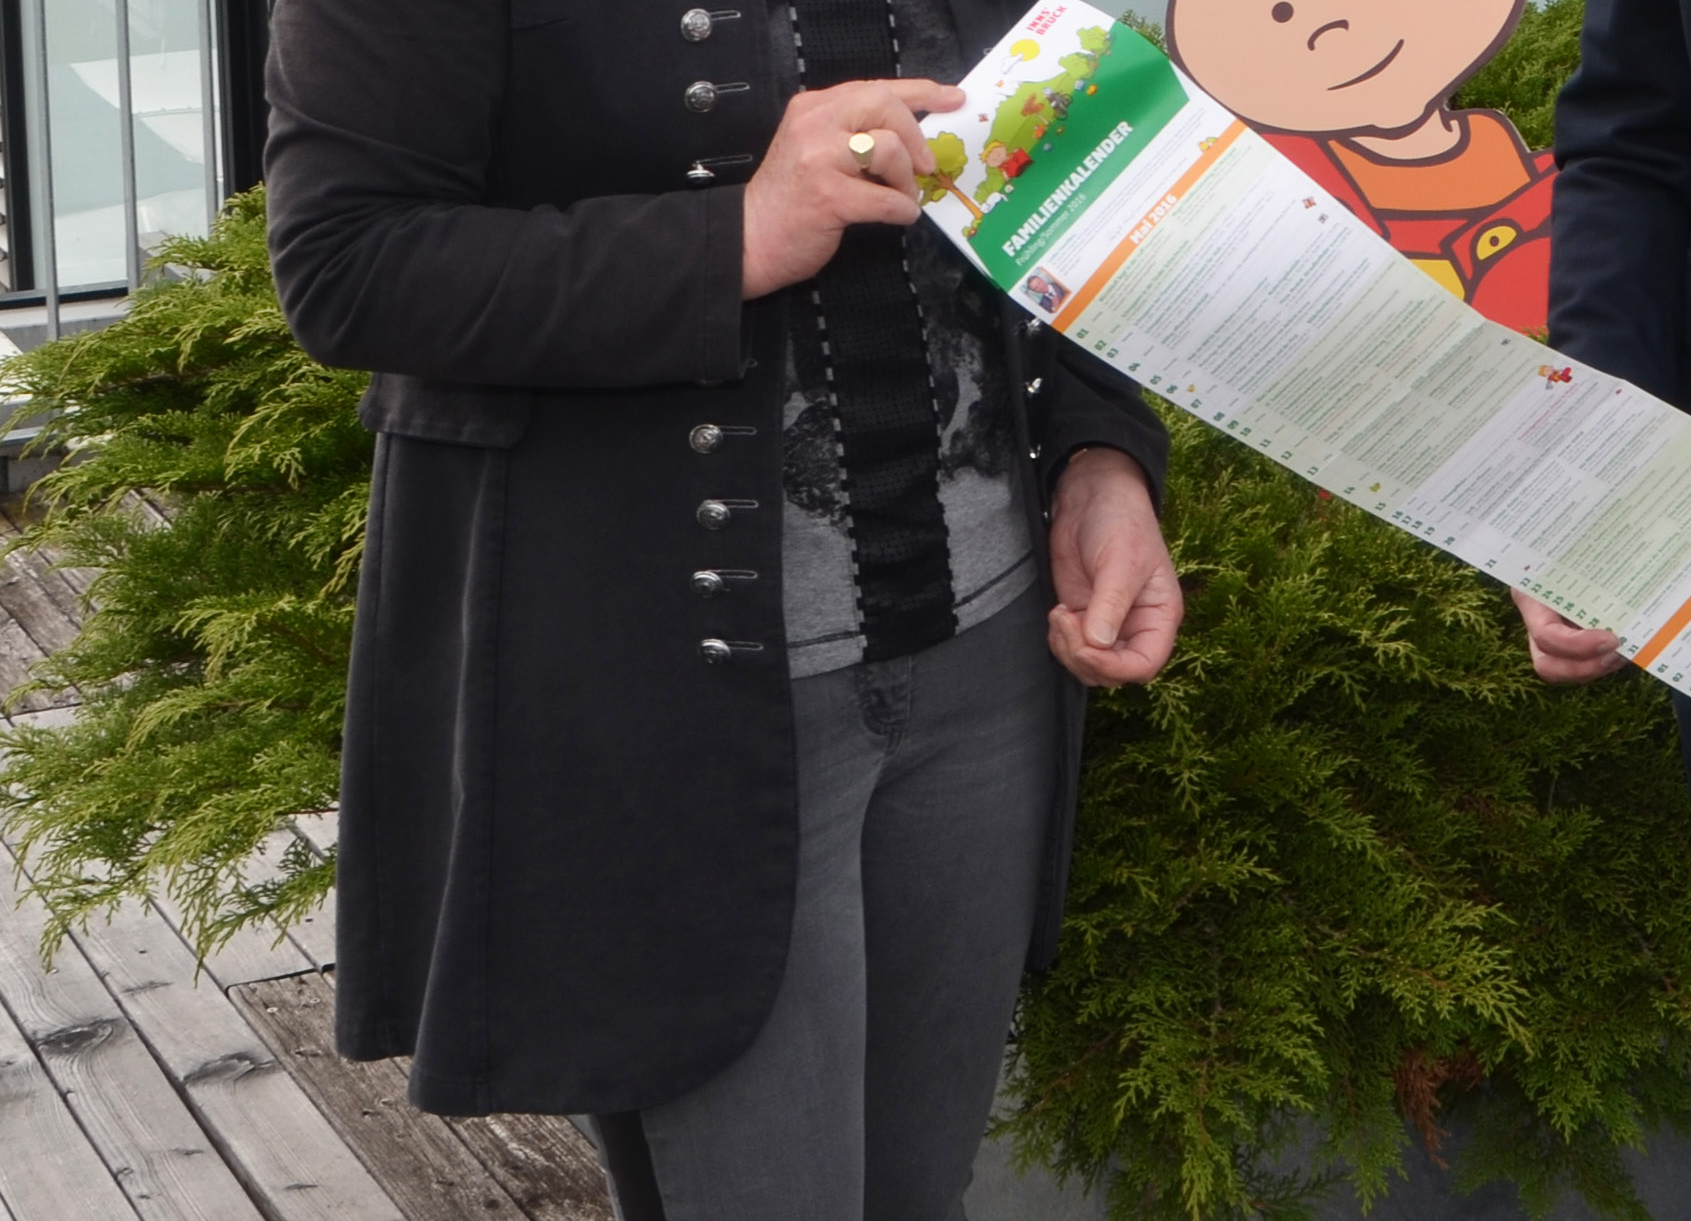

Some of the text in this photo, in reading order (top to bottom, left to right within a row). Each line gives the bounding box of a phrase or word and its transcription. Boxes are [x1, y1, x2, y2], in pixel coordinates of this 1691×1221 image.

[1036, 5, 1067, 35] BRUCK
[1002, 121, 1133, 257] FAMILIENKALENDER
[1067, 192, 1087, 213] 2016
[1129, 193, 1178, 245] Mai 2016
[1657, 663, 1668, 673] 01
[1672, 673, 1683, 682] 02
